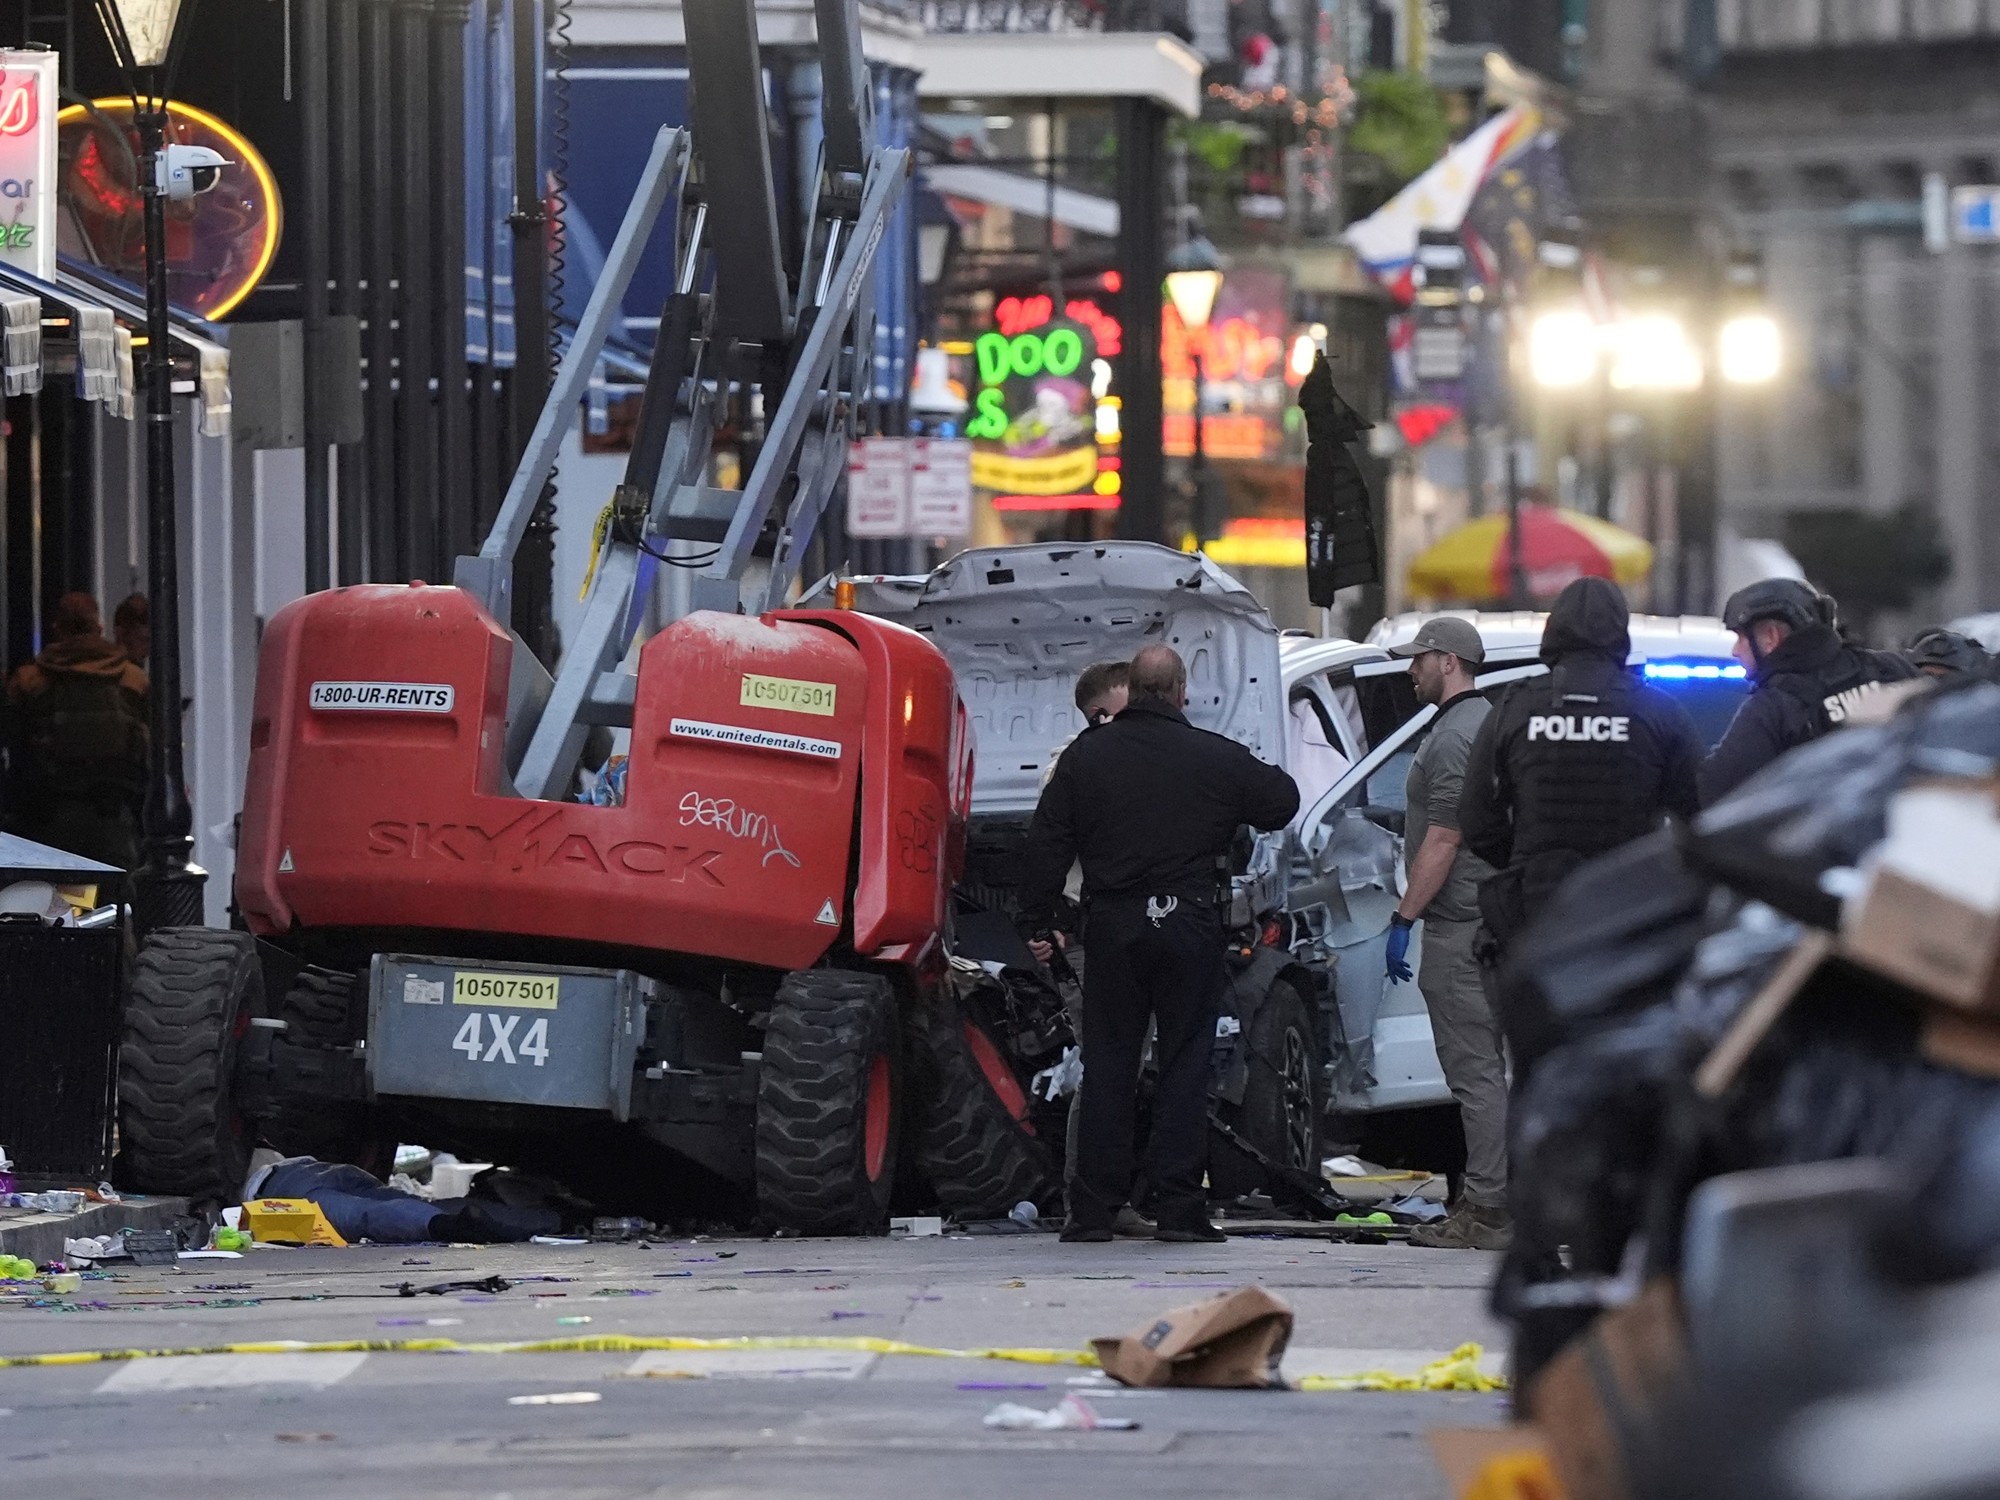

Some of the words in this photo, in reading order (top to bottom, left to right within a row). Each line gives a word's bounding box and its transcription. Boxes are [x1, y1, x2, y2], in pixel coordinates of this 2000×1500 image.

[314, 687, 448, 706] 1-800-UR-RENTS
[742, 681, 834, 707] 10507501
[674, 723, 837, 757] www.unitedrentals.com
[1527, 715, 1630, 742] POLICE
[368, 806, 725, 887] SKYJACK
[455, 977, 555, 1001] 10507501
[452, 1012, 549, 1066] 4X4
